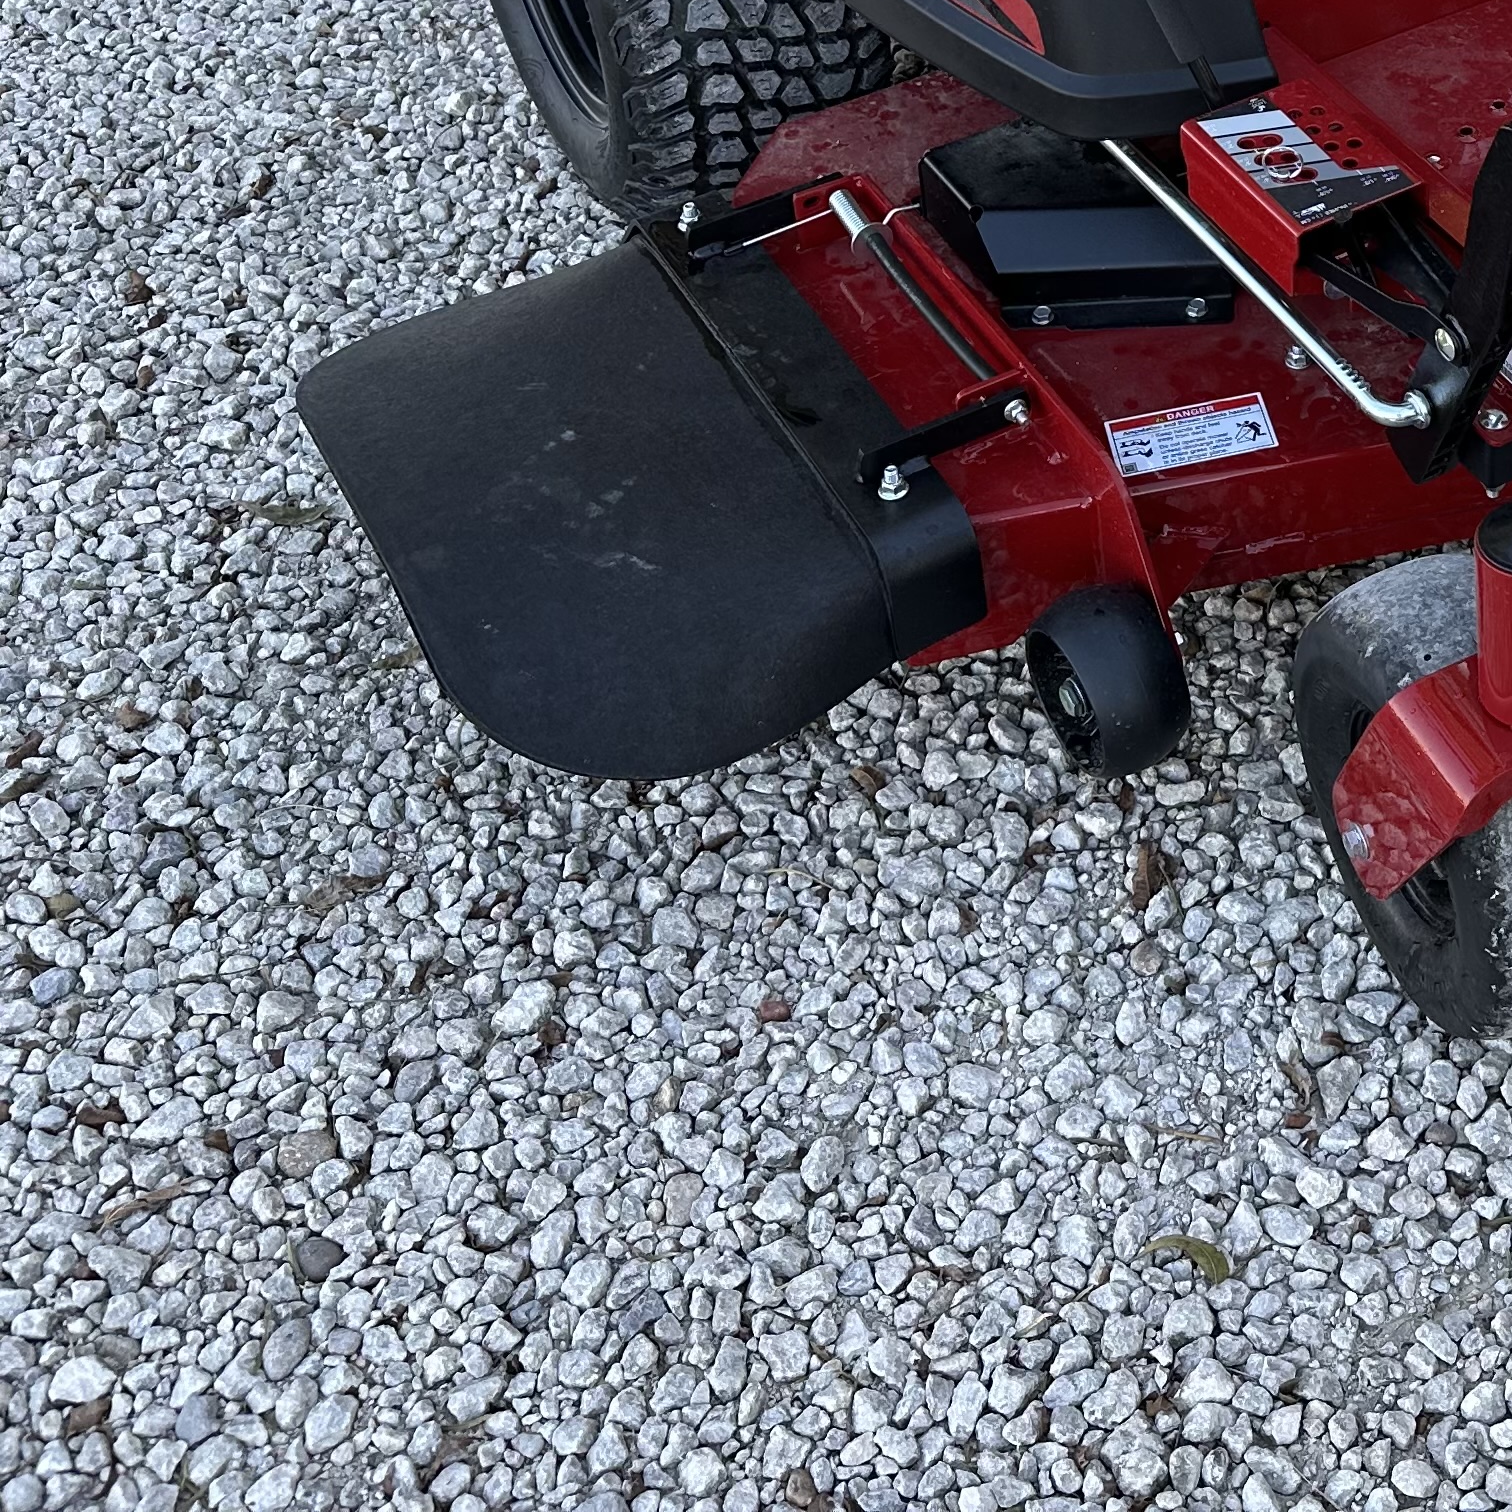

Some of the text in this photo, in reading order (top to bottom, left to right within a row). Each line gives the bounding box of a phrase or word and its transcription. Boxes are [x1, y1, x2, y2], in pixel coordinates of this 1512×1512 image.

[1166, 405, 1215, 421] DANGER
[1228, 407, 1252, 415] hazard
[1155, 430, 1173, 438] Keep
[1173, 426, 1194, 434] hands
